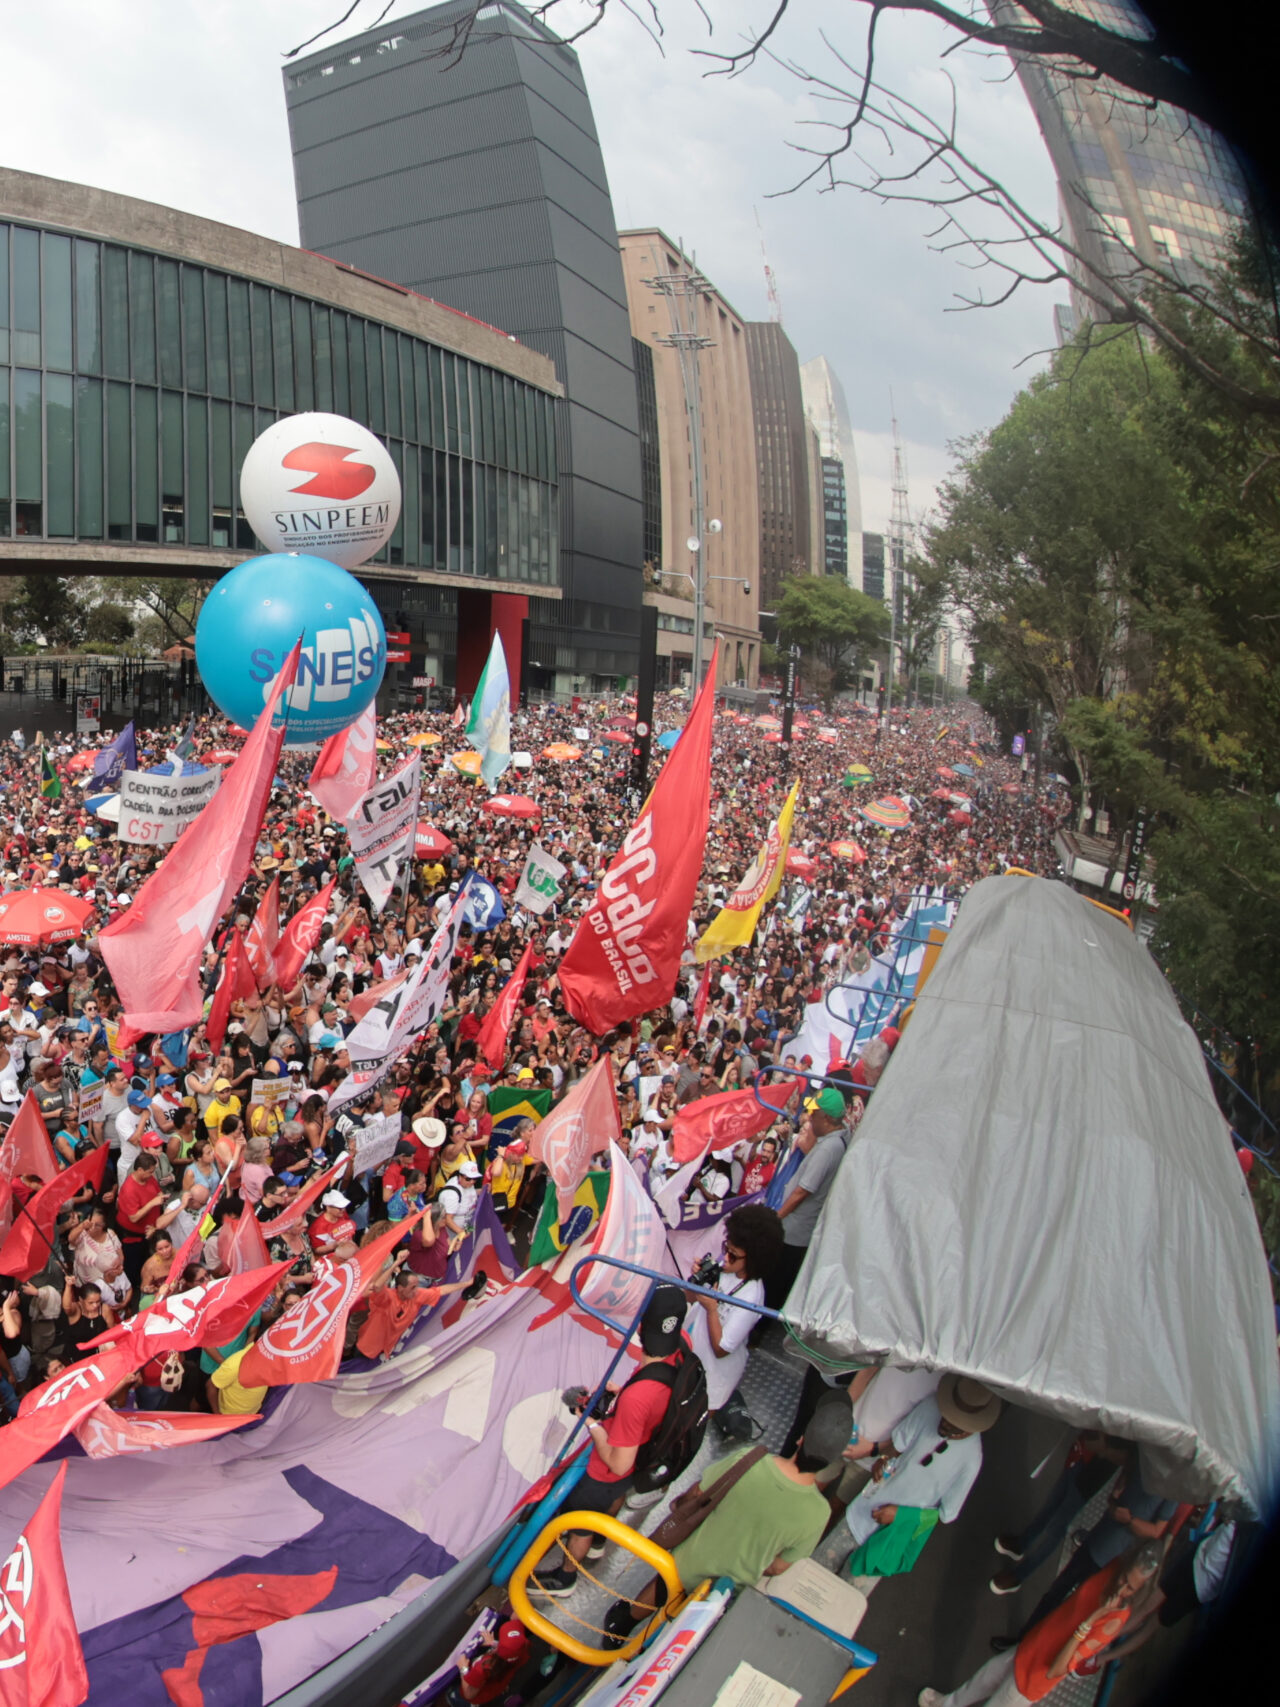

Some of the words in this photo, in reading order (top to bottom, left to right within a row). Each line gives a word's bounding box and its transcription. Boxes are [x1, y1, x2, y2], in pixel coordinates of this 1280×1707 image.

[275, 503, 390, 533] SINPEEM
[412, 676, 433, 688] MASP
[786, 662, 795, 698] Pamplona
[128, 781, 178, 798] CENTRÃO
[123, 798, 155, 816] CADEIA
[127, 819, 165, 841] CST
[6, 933, 32, 942] AMSTEL
[588, 911, 609, 935] DO
[600, 938, 634, 996] BRASIL
[81, 1095, 102, 1110] SEM
[79, 1103, 103, 1120] ANISTIA
[289, 1355, 310, 1365] TETO
[652, 1643, 686, 1680] UGT
